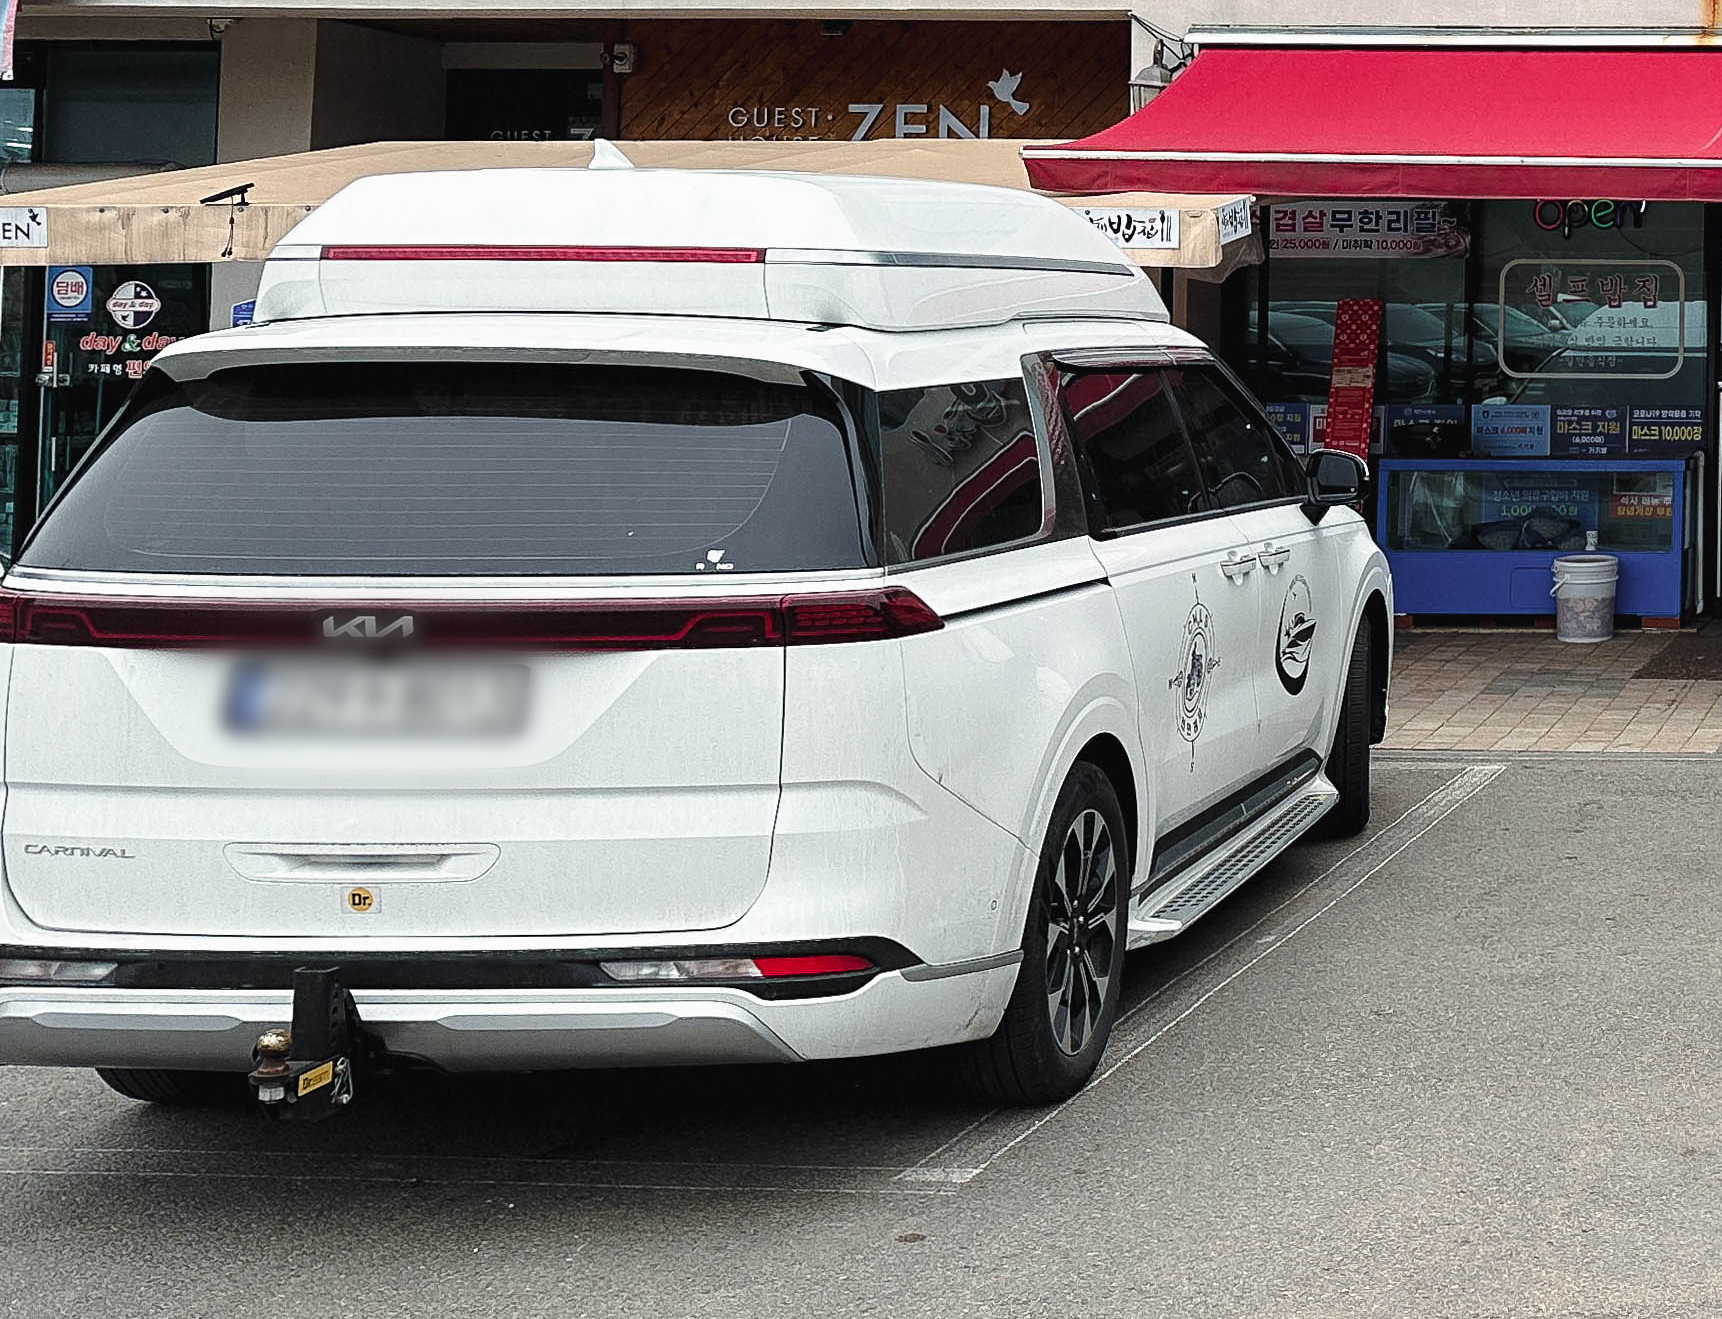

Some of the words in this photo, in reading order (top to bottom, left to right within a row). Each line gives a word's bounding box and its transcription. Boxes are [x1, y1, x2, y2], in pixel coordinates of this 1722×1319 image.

[727, 106, 820, 128] GUEST
[56, 281, 84, 296] 담배
[79, 332, 123, 355] day
[121, 334, 141, 352] &
[1556, 421, 1593, 435] 마스크
[1596, 421, 1621, 435] 지원
[1632, 425, 1660, 440] 마스크
[1660, 425, 1703, 442] 10,000장
[323, 615, 414, 638] KIA
[24, 843, 136, 859] CARNIVAL
[351, 892, 373, 910] Dr.
